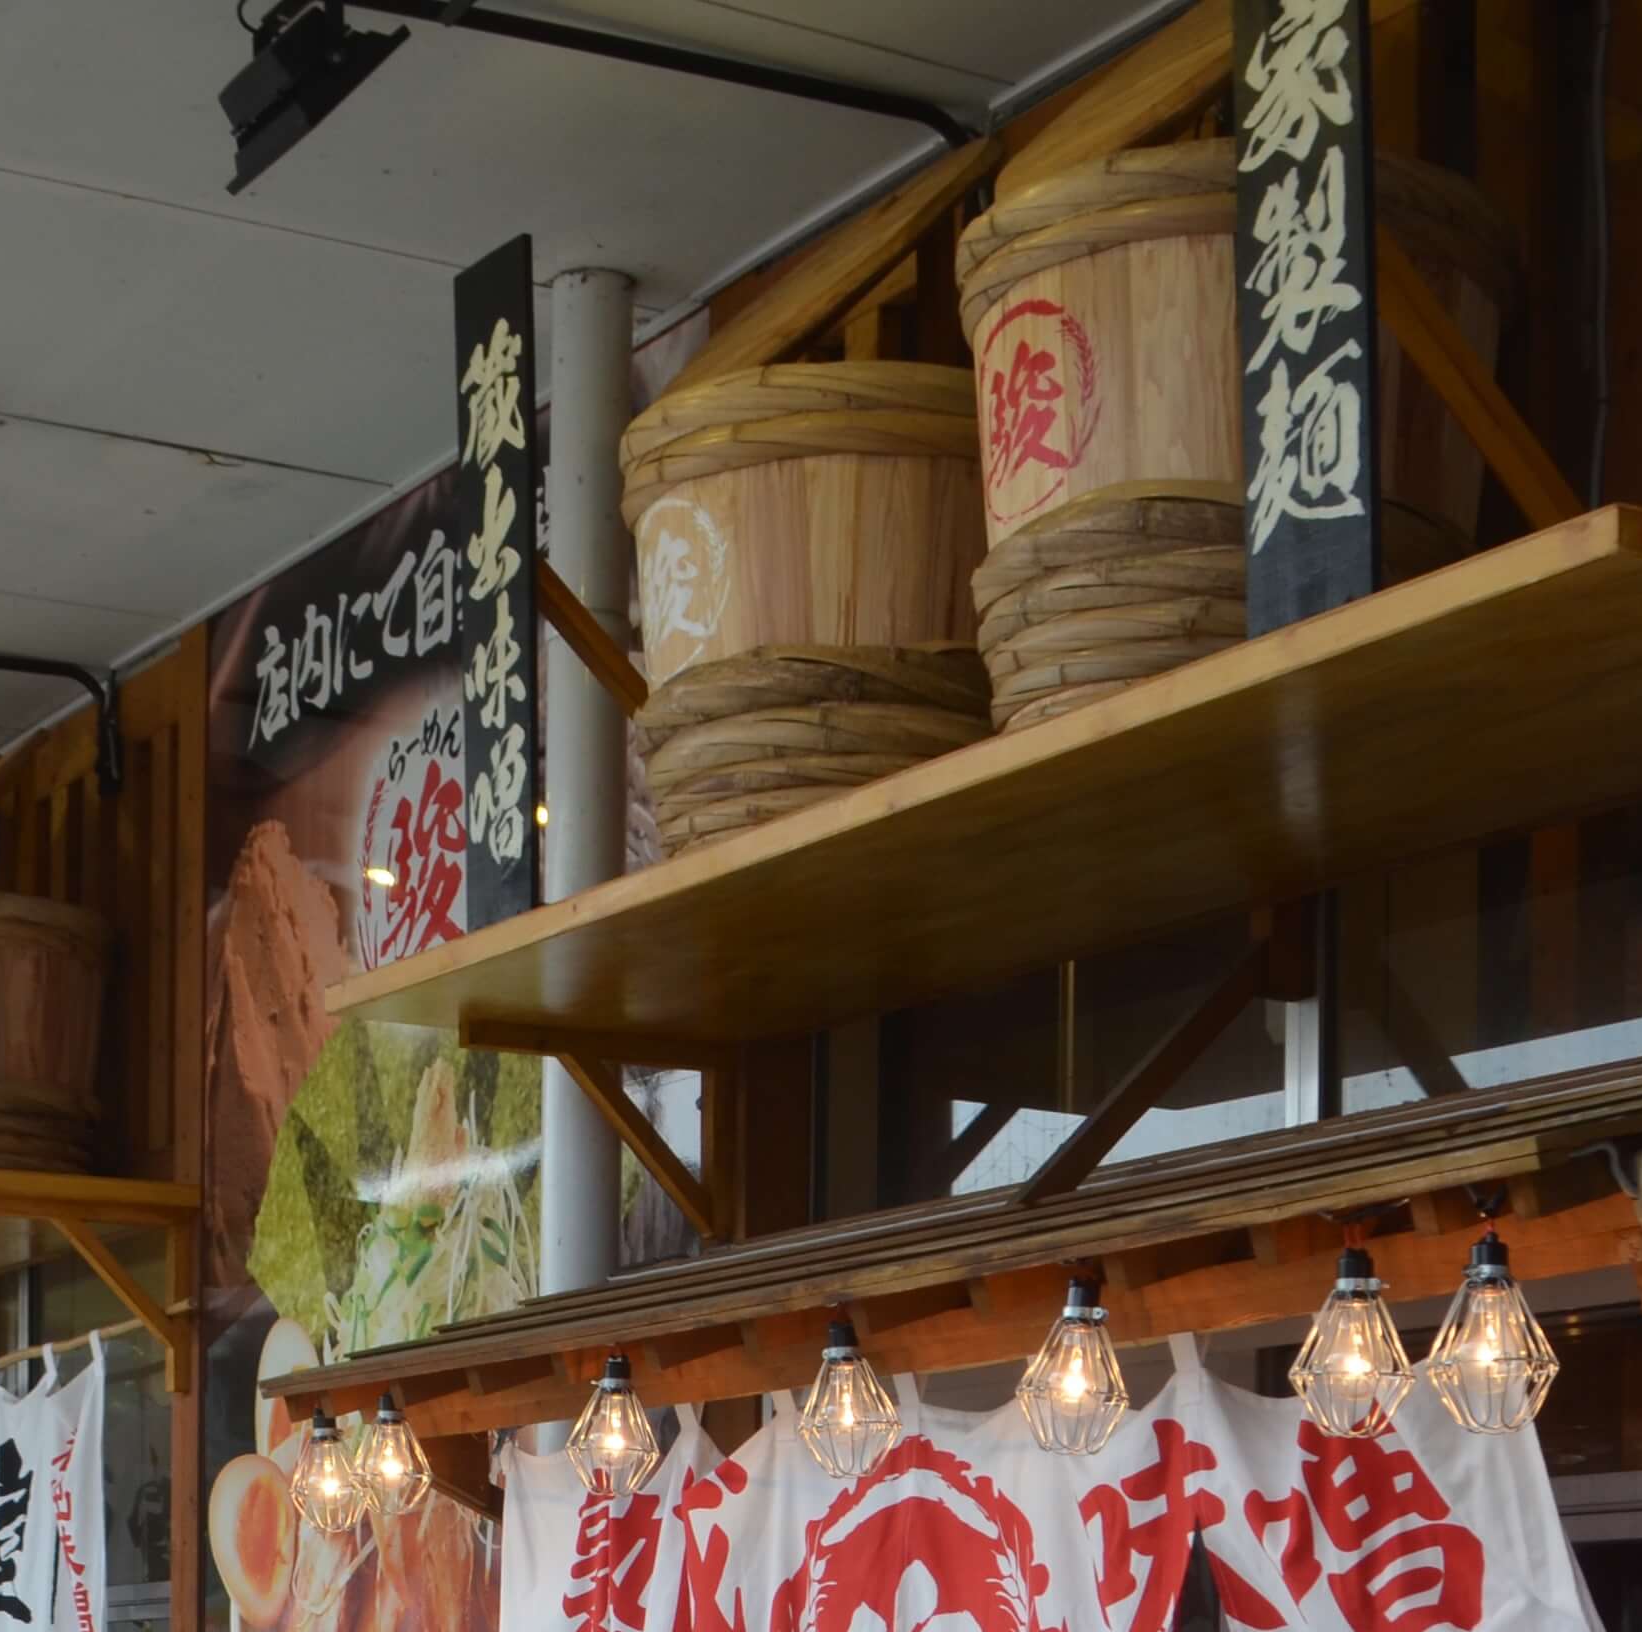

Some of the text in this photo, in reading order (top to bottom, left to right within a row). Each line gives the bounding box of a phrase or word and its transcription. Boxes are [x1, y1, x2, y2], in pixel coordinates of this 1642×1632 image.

[1238, 0, 1365, 556] 家製麺
[387, 709, 462, 783] らーめん
[460, 316, 528, 865] 蔵出味噌
